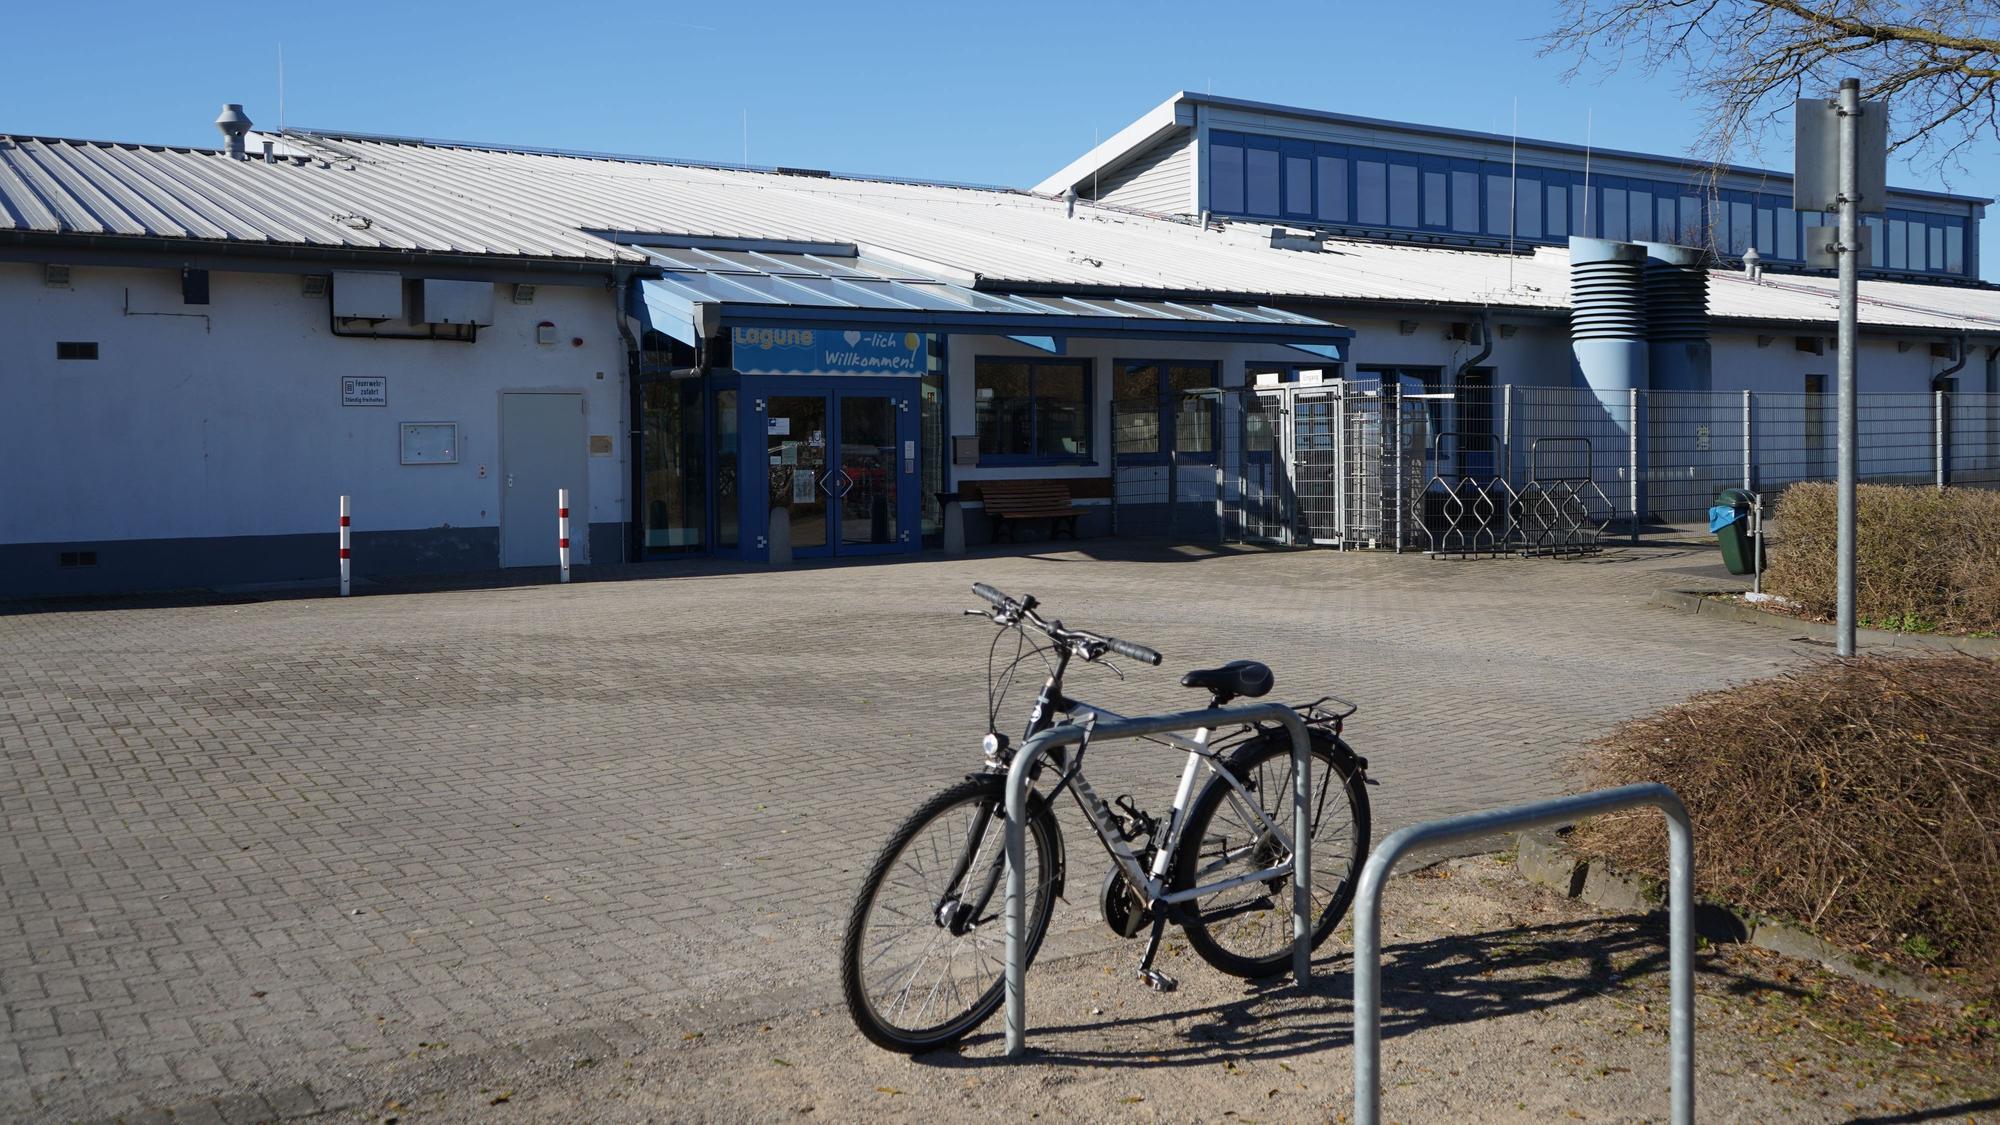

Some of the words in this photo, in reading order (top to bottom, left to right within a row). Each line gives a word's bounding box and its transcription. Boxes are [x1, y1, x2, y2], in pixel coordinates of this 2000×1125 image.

[735, 327, 813, 349] Lagune
[863, 333, 896, 348] -lich
[825, 350, 916, 368] Willkommen!
